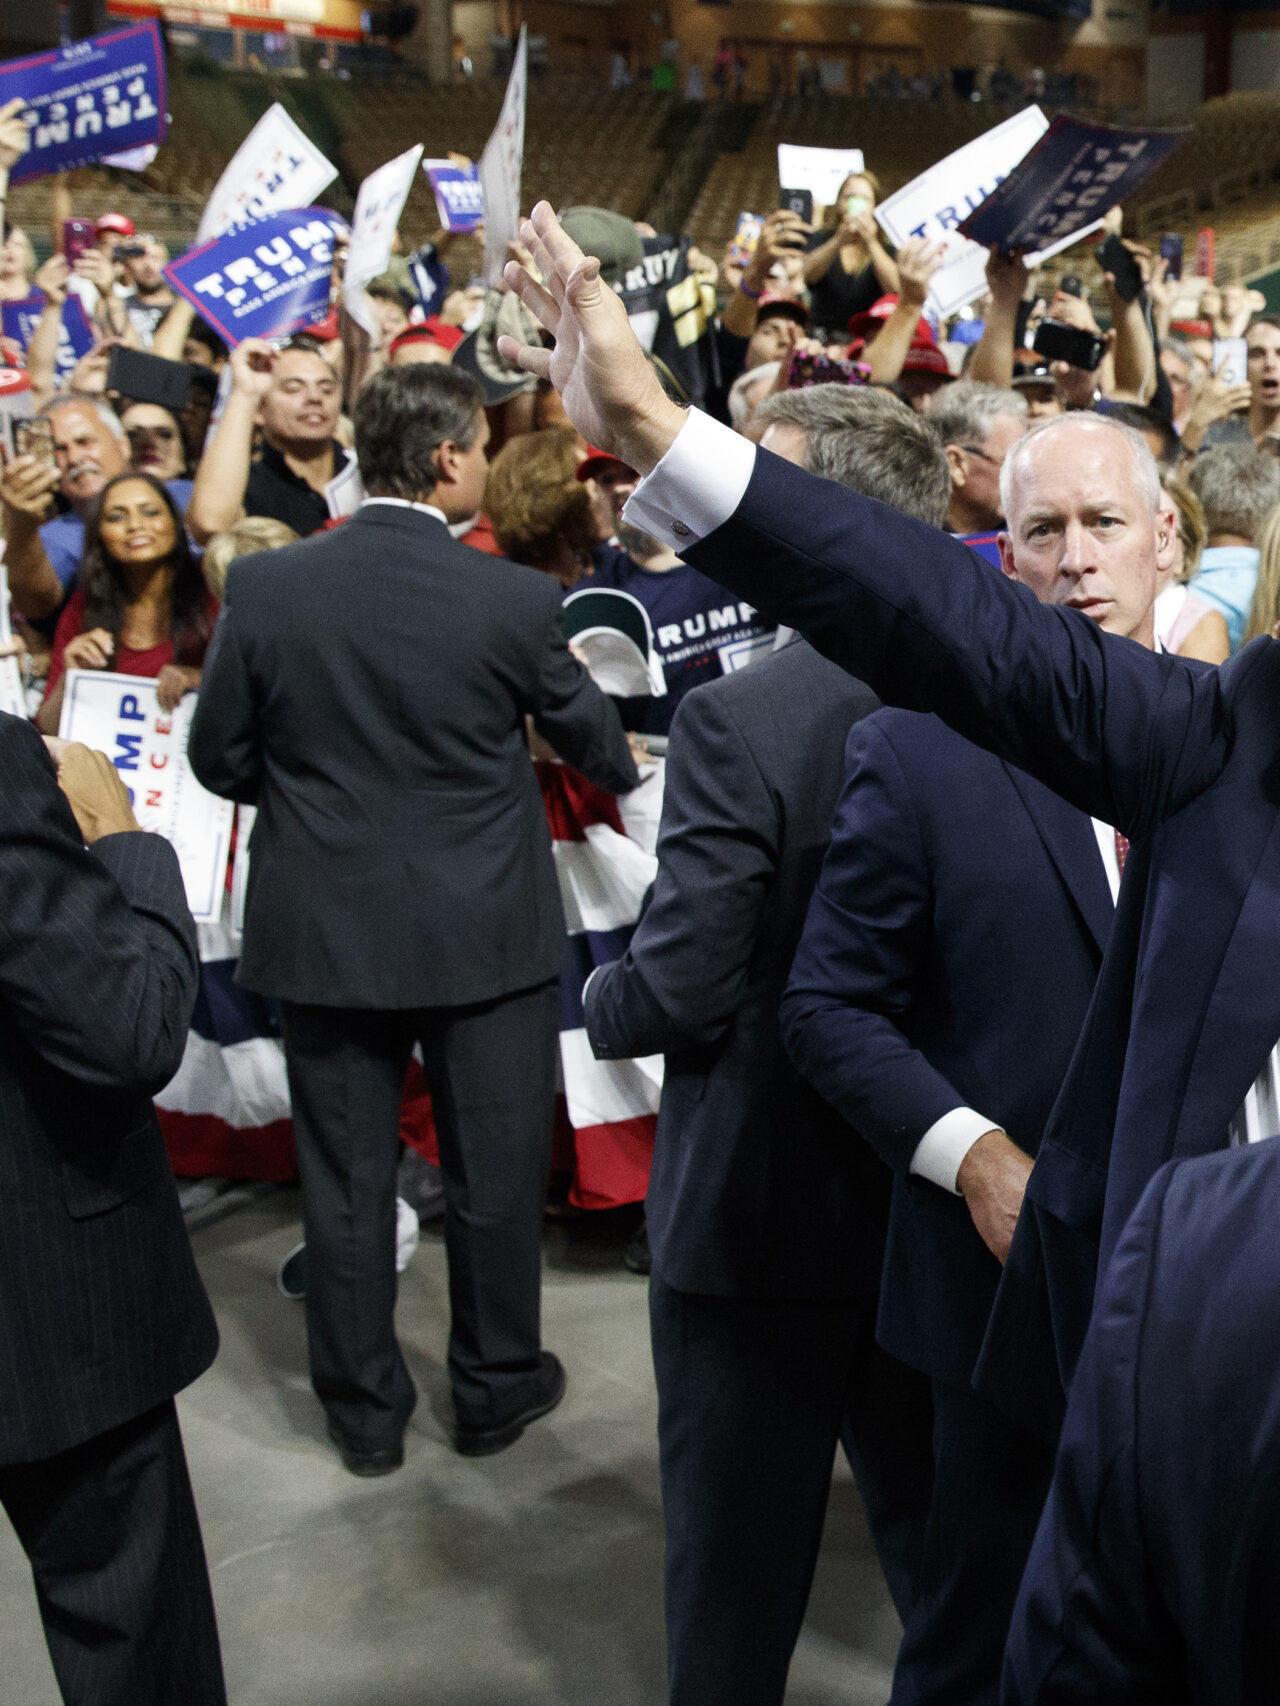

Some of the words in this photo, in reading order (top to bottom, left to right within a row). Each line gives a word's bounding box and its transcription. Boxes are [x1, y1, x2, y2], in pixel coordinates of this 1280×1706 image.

[34, 92, 157, 148] TRUM
[224, 242, 334, 307] PENC
[113, 694, 145, 807] MP
[143, 718, 172, 834] NCE
